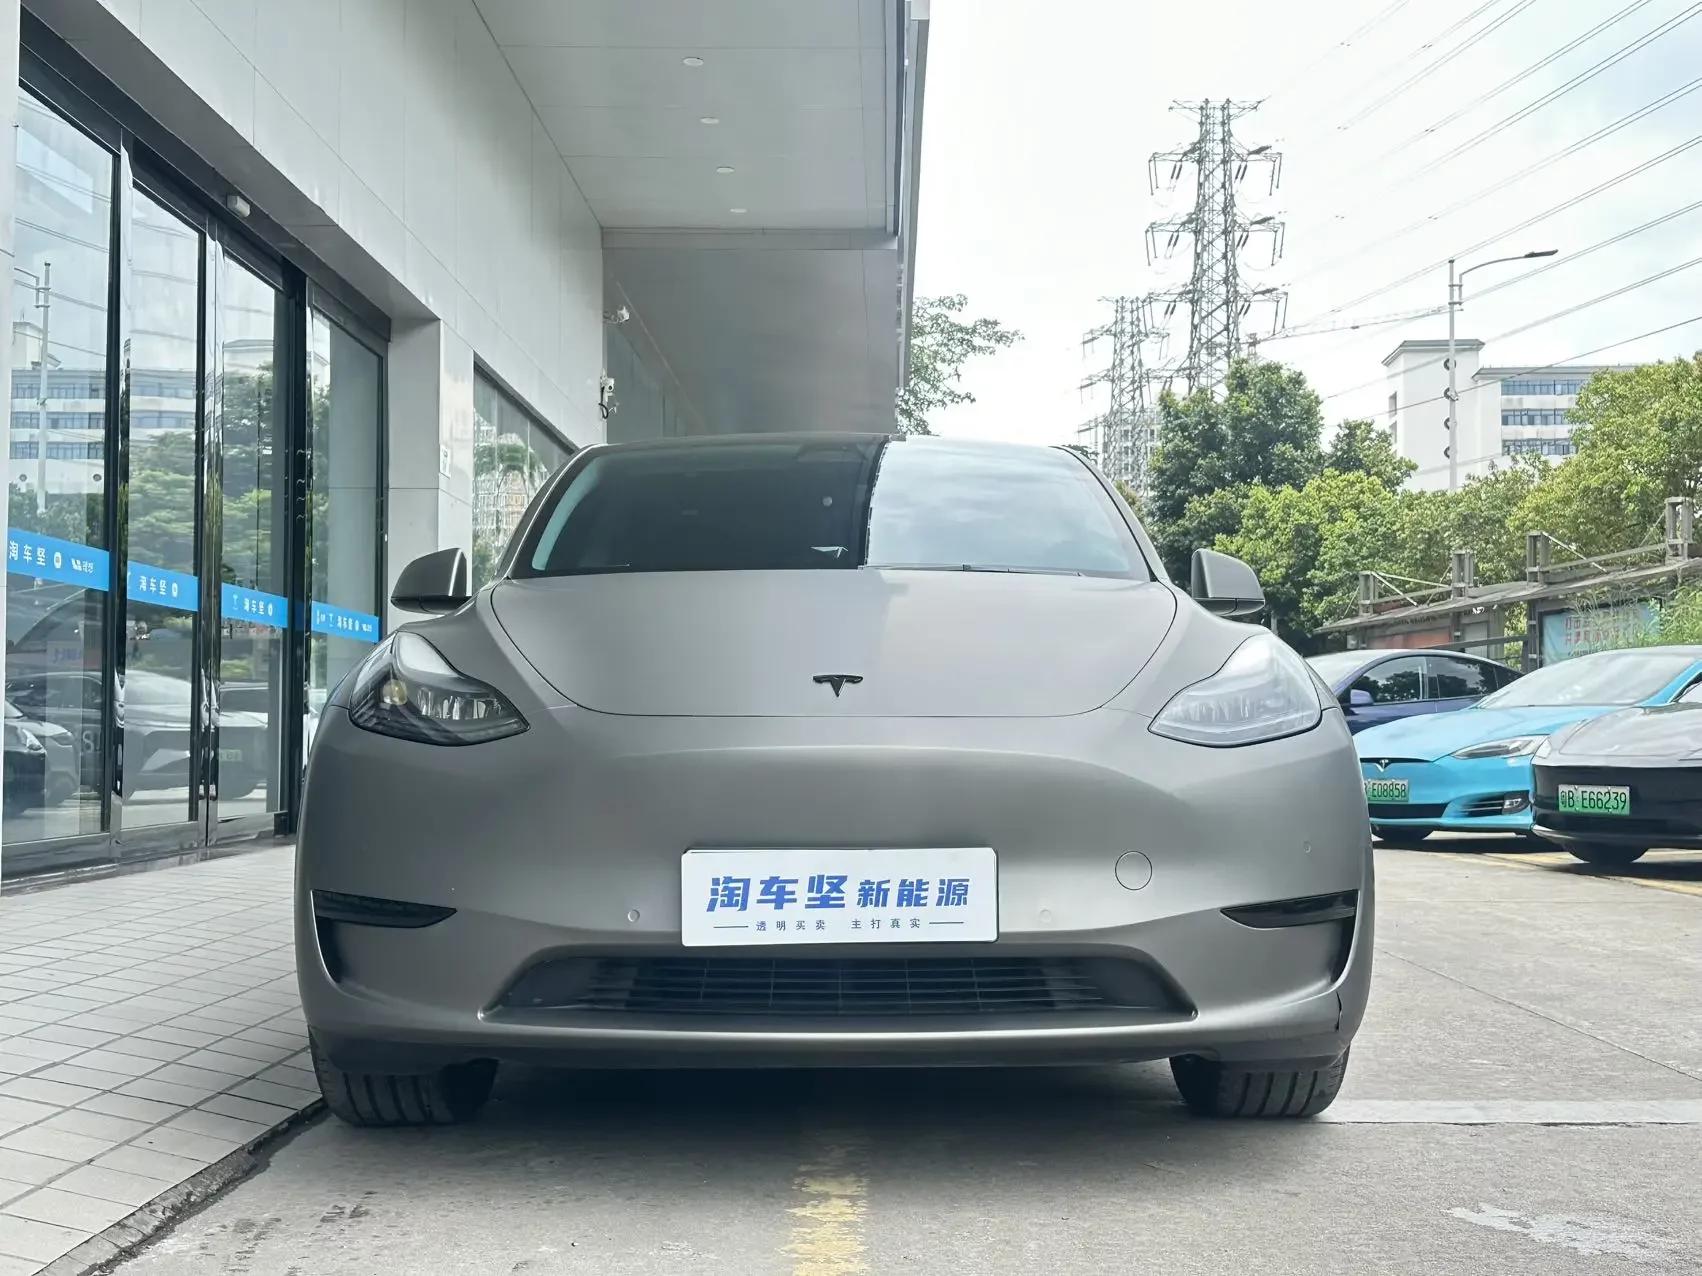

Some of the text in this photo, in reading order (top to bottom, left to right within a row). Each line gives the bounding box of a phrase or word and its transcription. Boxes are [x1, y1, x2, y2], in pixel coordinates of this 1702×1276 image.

[9, 541, 46, 566] 淘车坚
[756, 917, 921, 932] 透明买卖 主打真实
